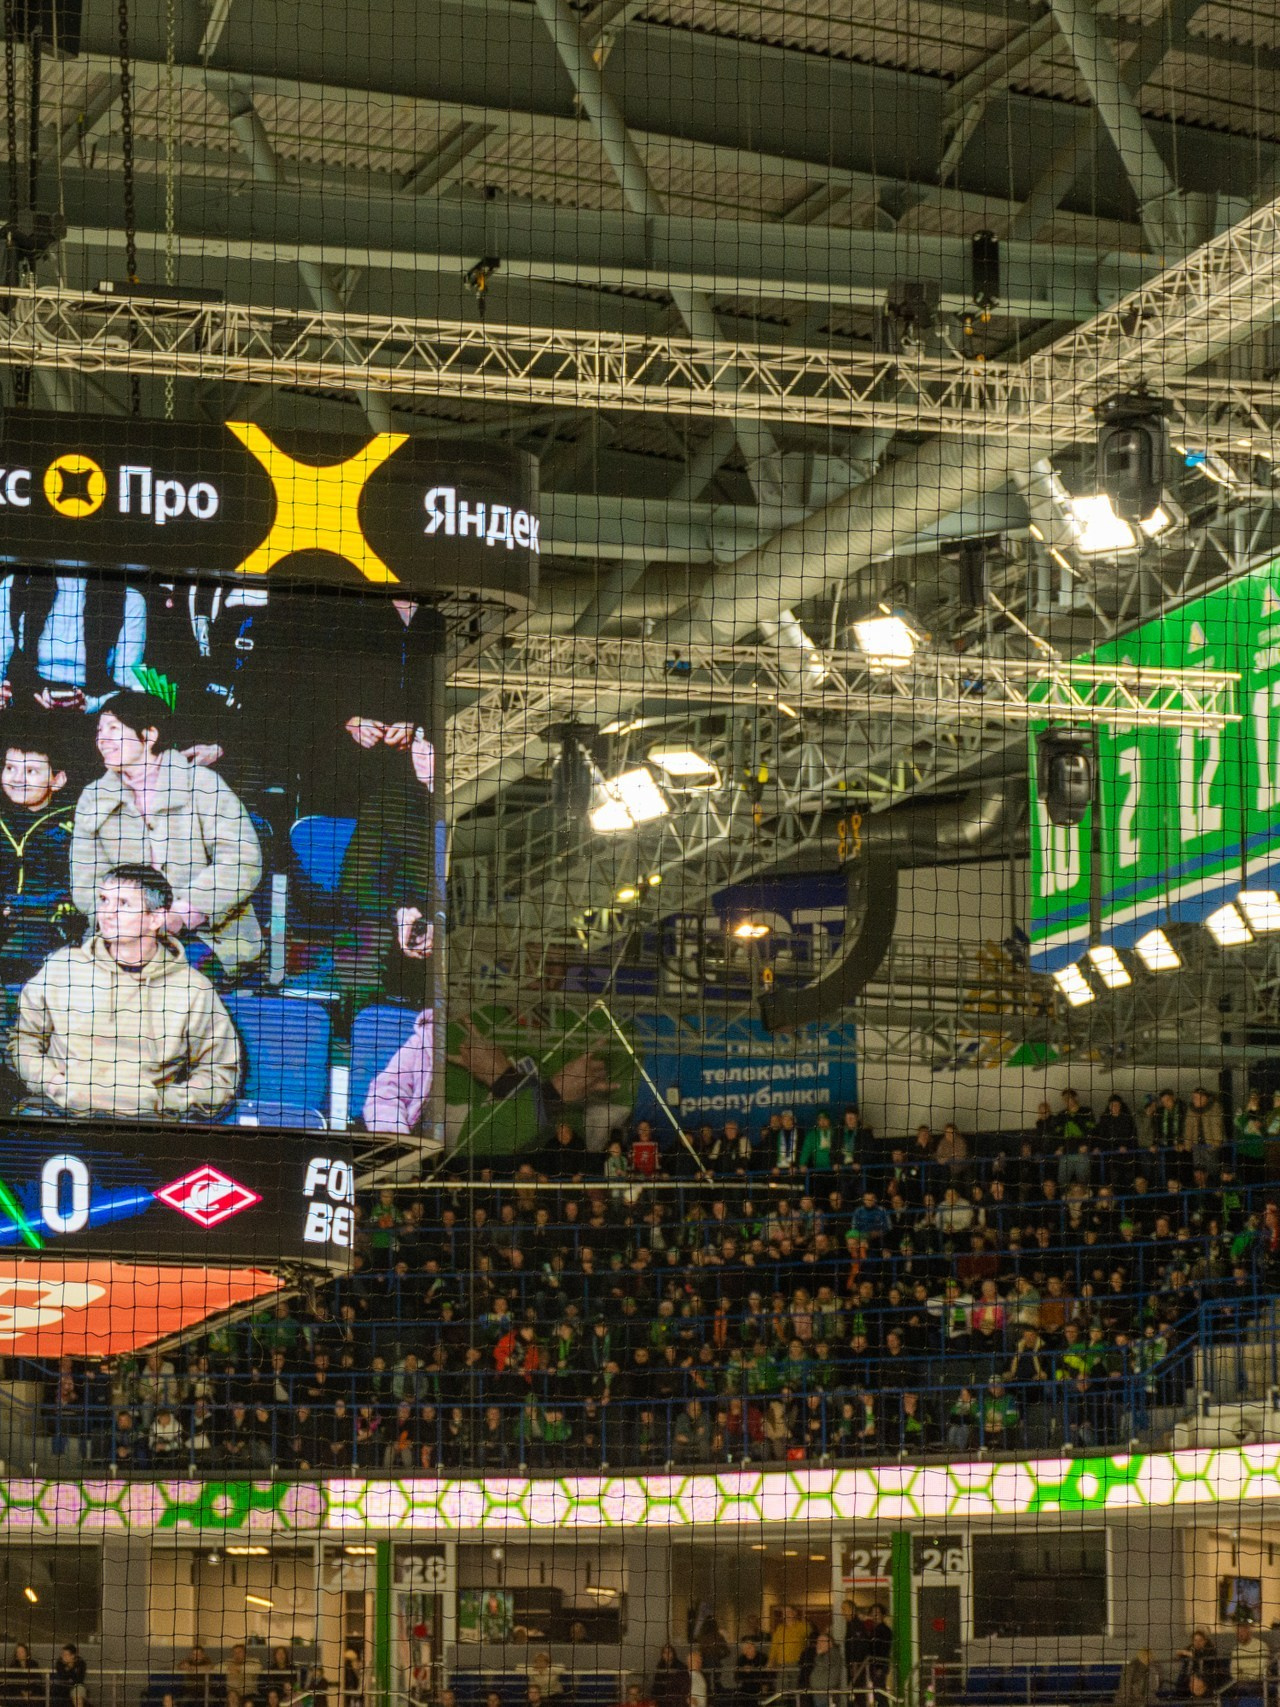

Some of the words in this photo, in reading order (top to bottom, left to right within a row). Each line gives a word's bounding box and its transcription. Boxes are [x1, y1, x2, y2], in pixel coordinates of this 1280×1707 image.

[119, 465, 219, 525] Про
[1118, 746, 1141, 869] 2
[702, 1062, 829, 1084] телеканал
[680, 1087, 830, 1117] республики
[40, 1153, 91, 1234] 0
[401, 1556, 446, 1584] 28
[850, 1549, 892, 1577] 27
[922, 1548, 964, 1577] 26
